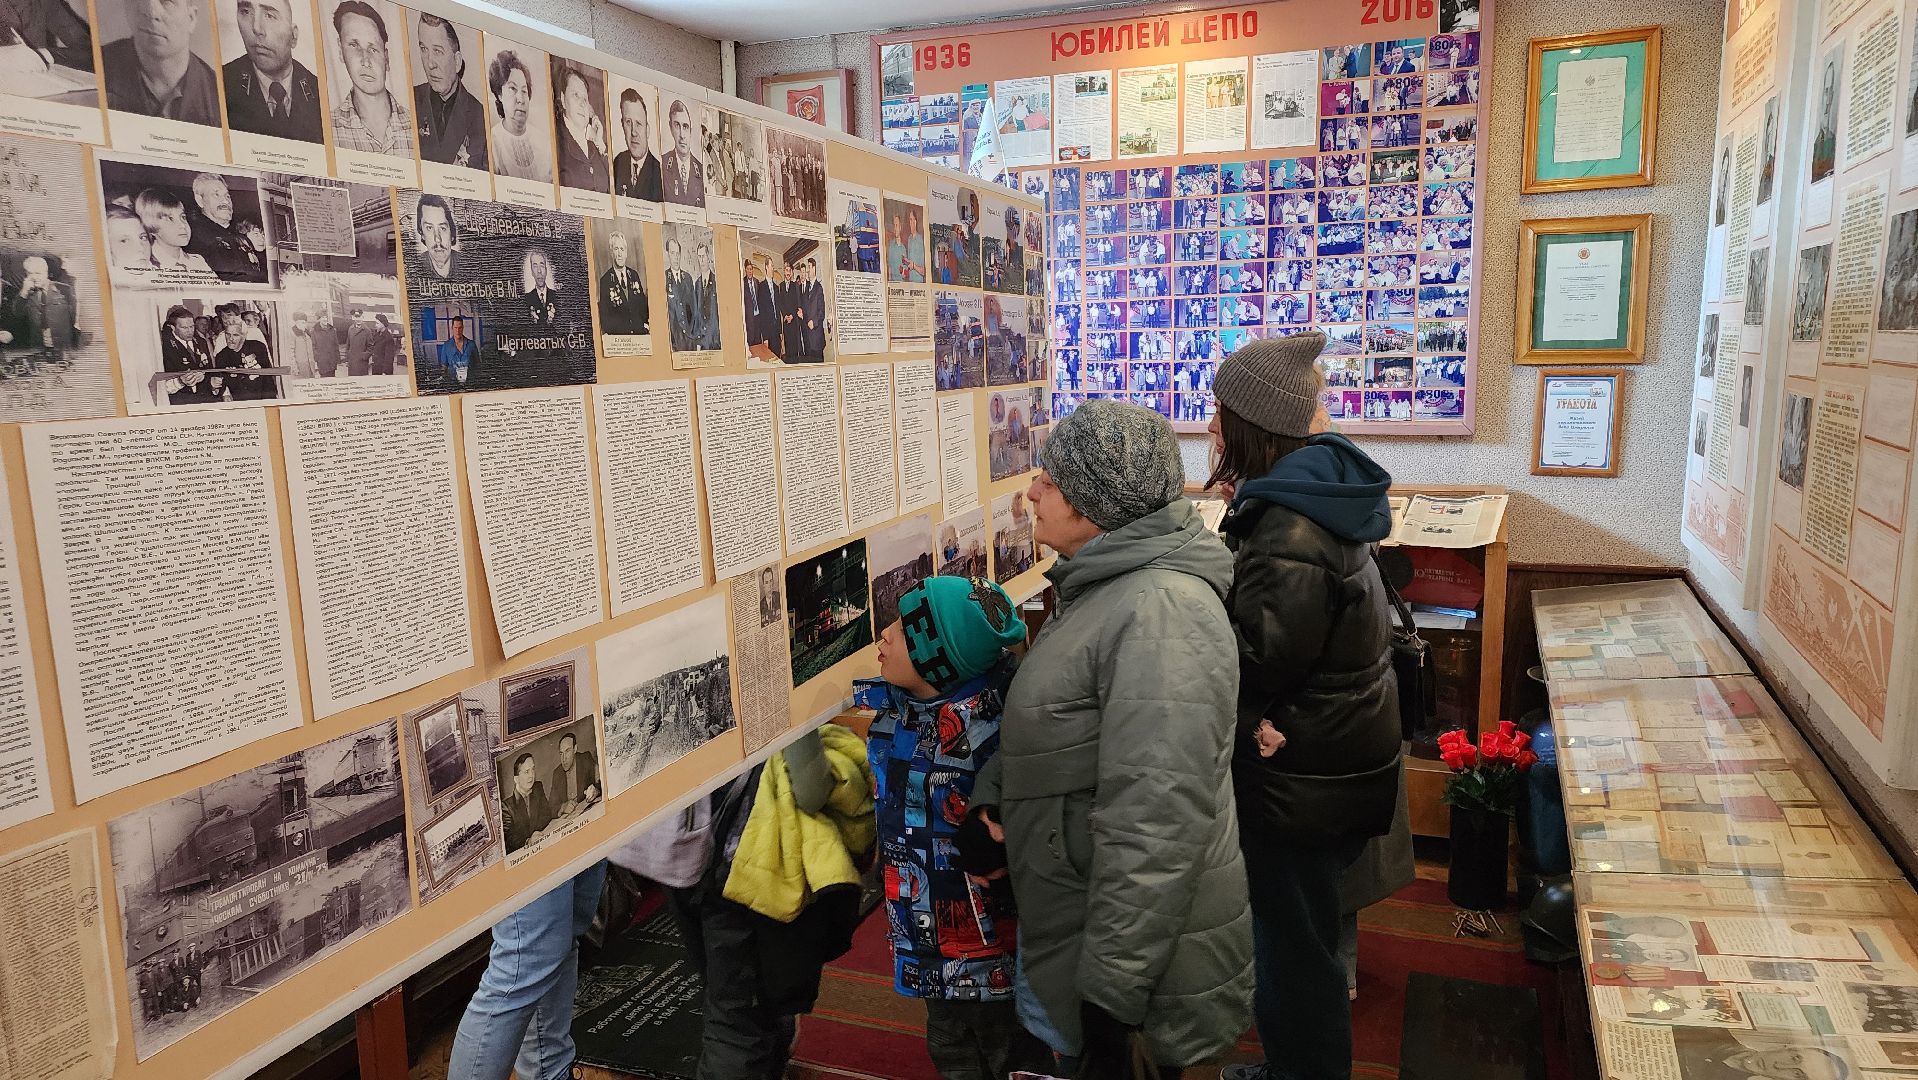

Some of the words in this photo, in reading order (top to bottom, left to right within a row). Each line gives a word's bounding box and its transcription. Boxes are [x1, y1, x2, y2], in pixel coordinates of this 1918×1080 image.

[1361, 0, 1434, 25] 2016
[1051, 18, 1170, 62] ЮБИЛЕЙ
[1181, 10, 1258, 45] ДЕПО
[915, 42, 971, 71] 1936
[418, 278, 494, 298] Щеглеватых
[497, 333, 565, 353] Щеглеватых
[1557, 399, 1597, 409] ГРАМОТА
[587, 1000, 633, 1034] Работники
[658, 1005, 679, 1021] 1941
